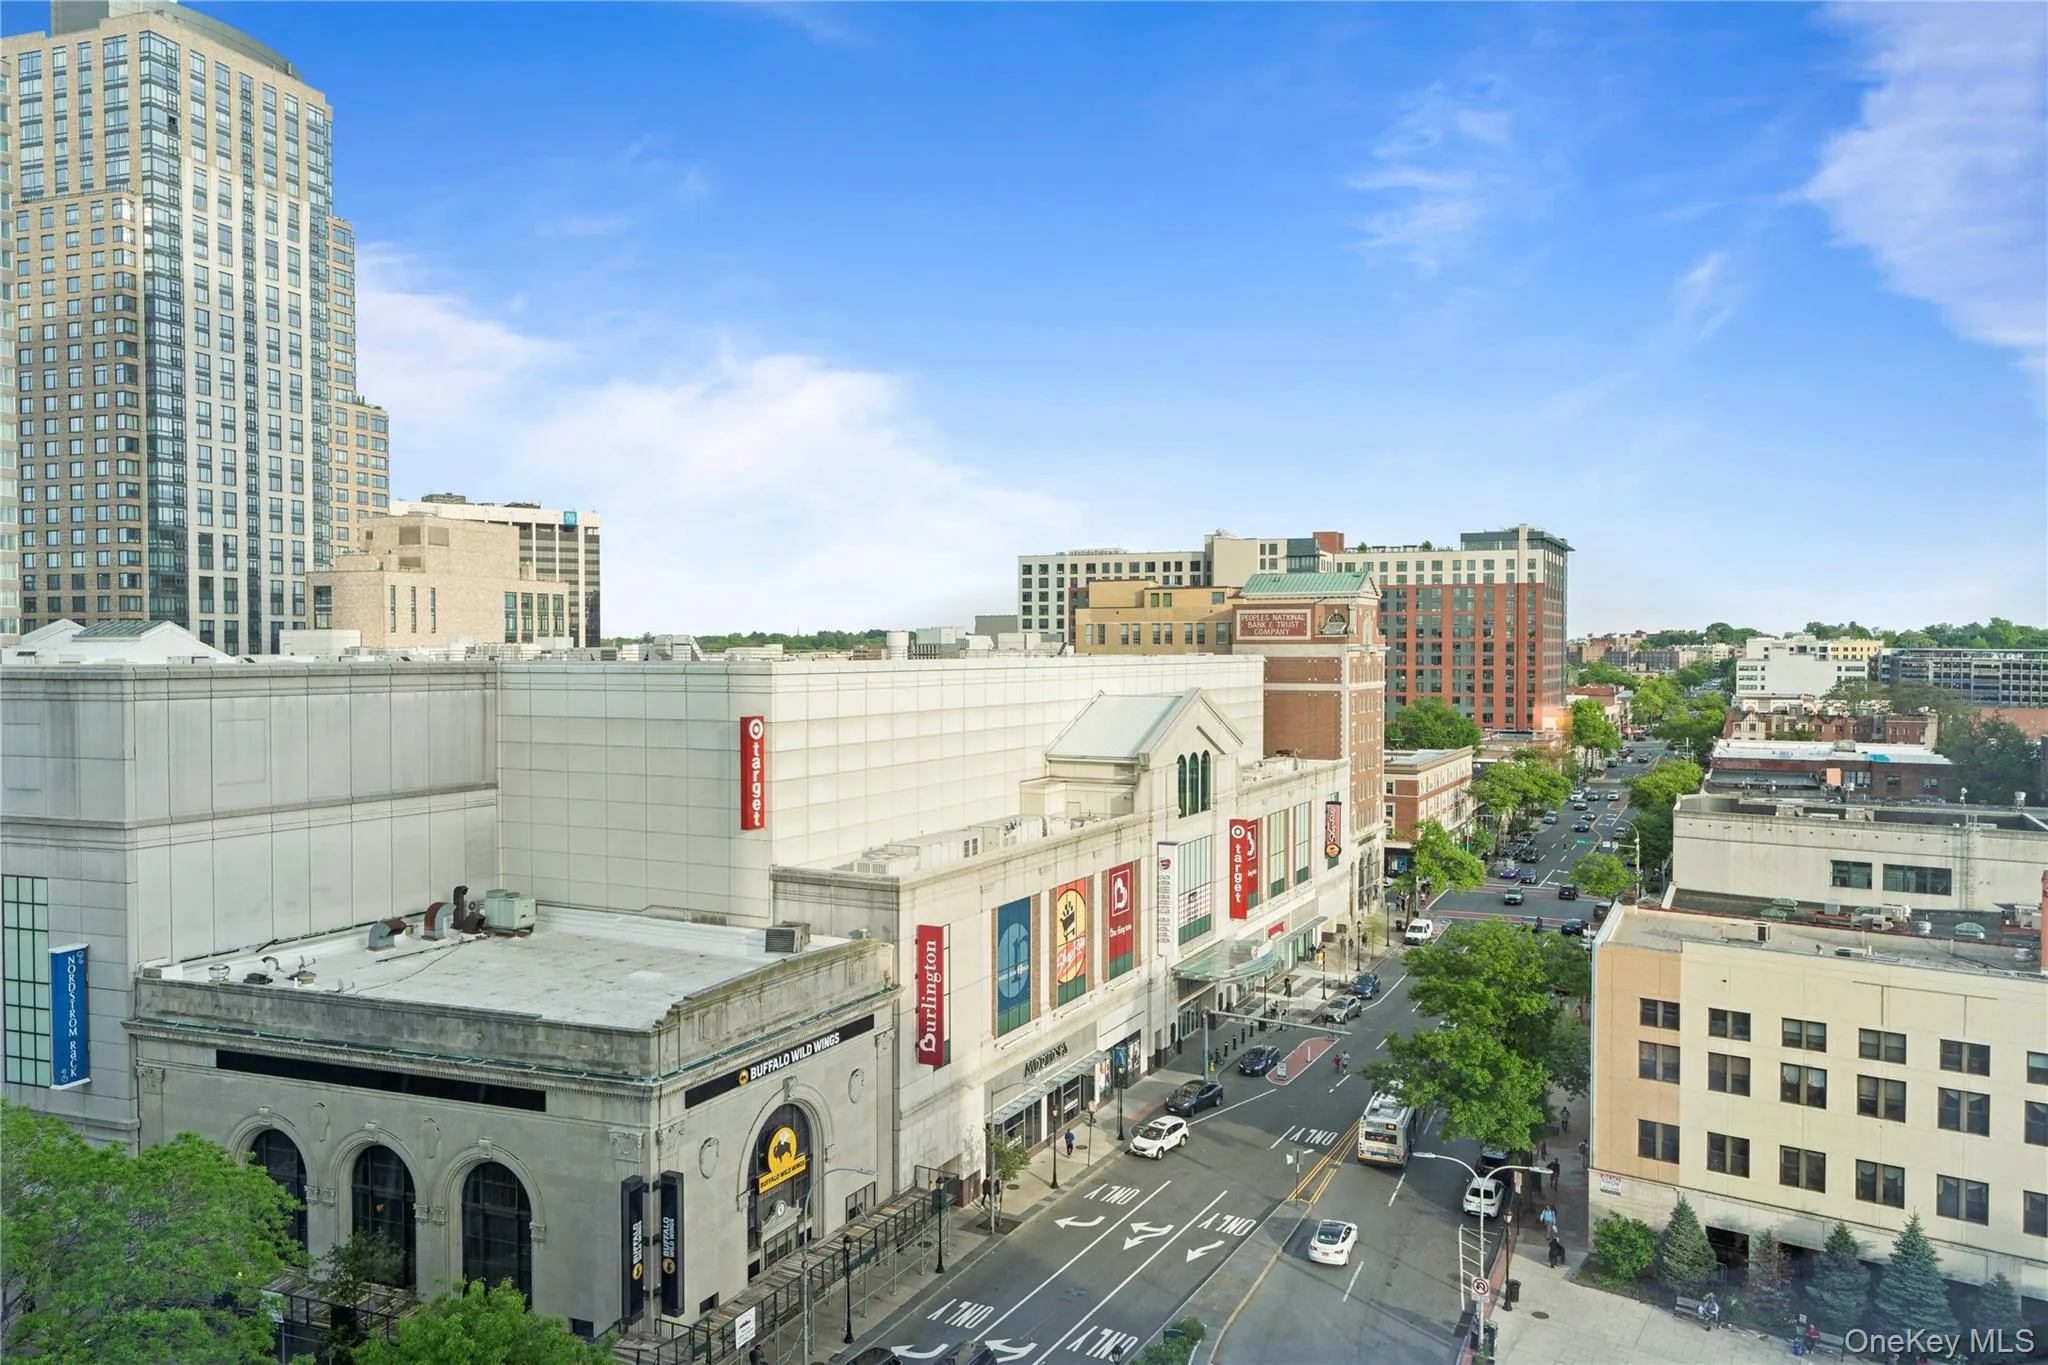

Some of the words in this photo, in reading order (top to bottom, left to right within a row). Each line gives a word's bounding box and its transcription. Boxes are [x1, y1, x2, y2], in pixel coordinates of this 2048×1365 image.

[751, 741, 761, 826] target
[1233, 843, 1242, 903] target
[67, 956, 78, 1037] NORDSTROM
[919, 940, 942, 1052] Burlington
[750, 1053, 790, 1080] BUFFALO
[790, 1043, 813, 1063] WILD
[813, 1032, 840, 1053] WINGS
[1289, 1127, 1338, 1146] ONLY
[1083, 1183, 1140, 1206] ONLY
[1197, 1212, 1257, 1237] ONLY
[926, 1298, 994, 1329] ONLY
[1065, 1325, 1139, 1362] ONLY
